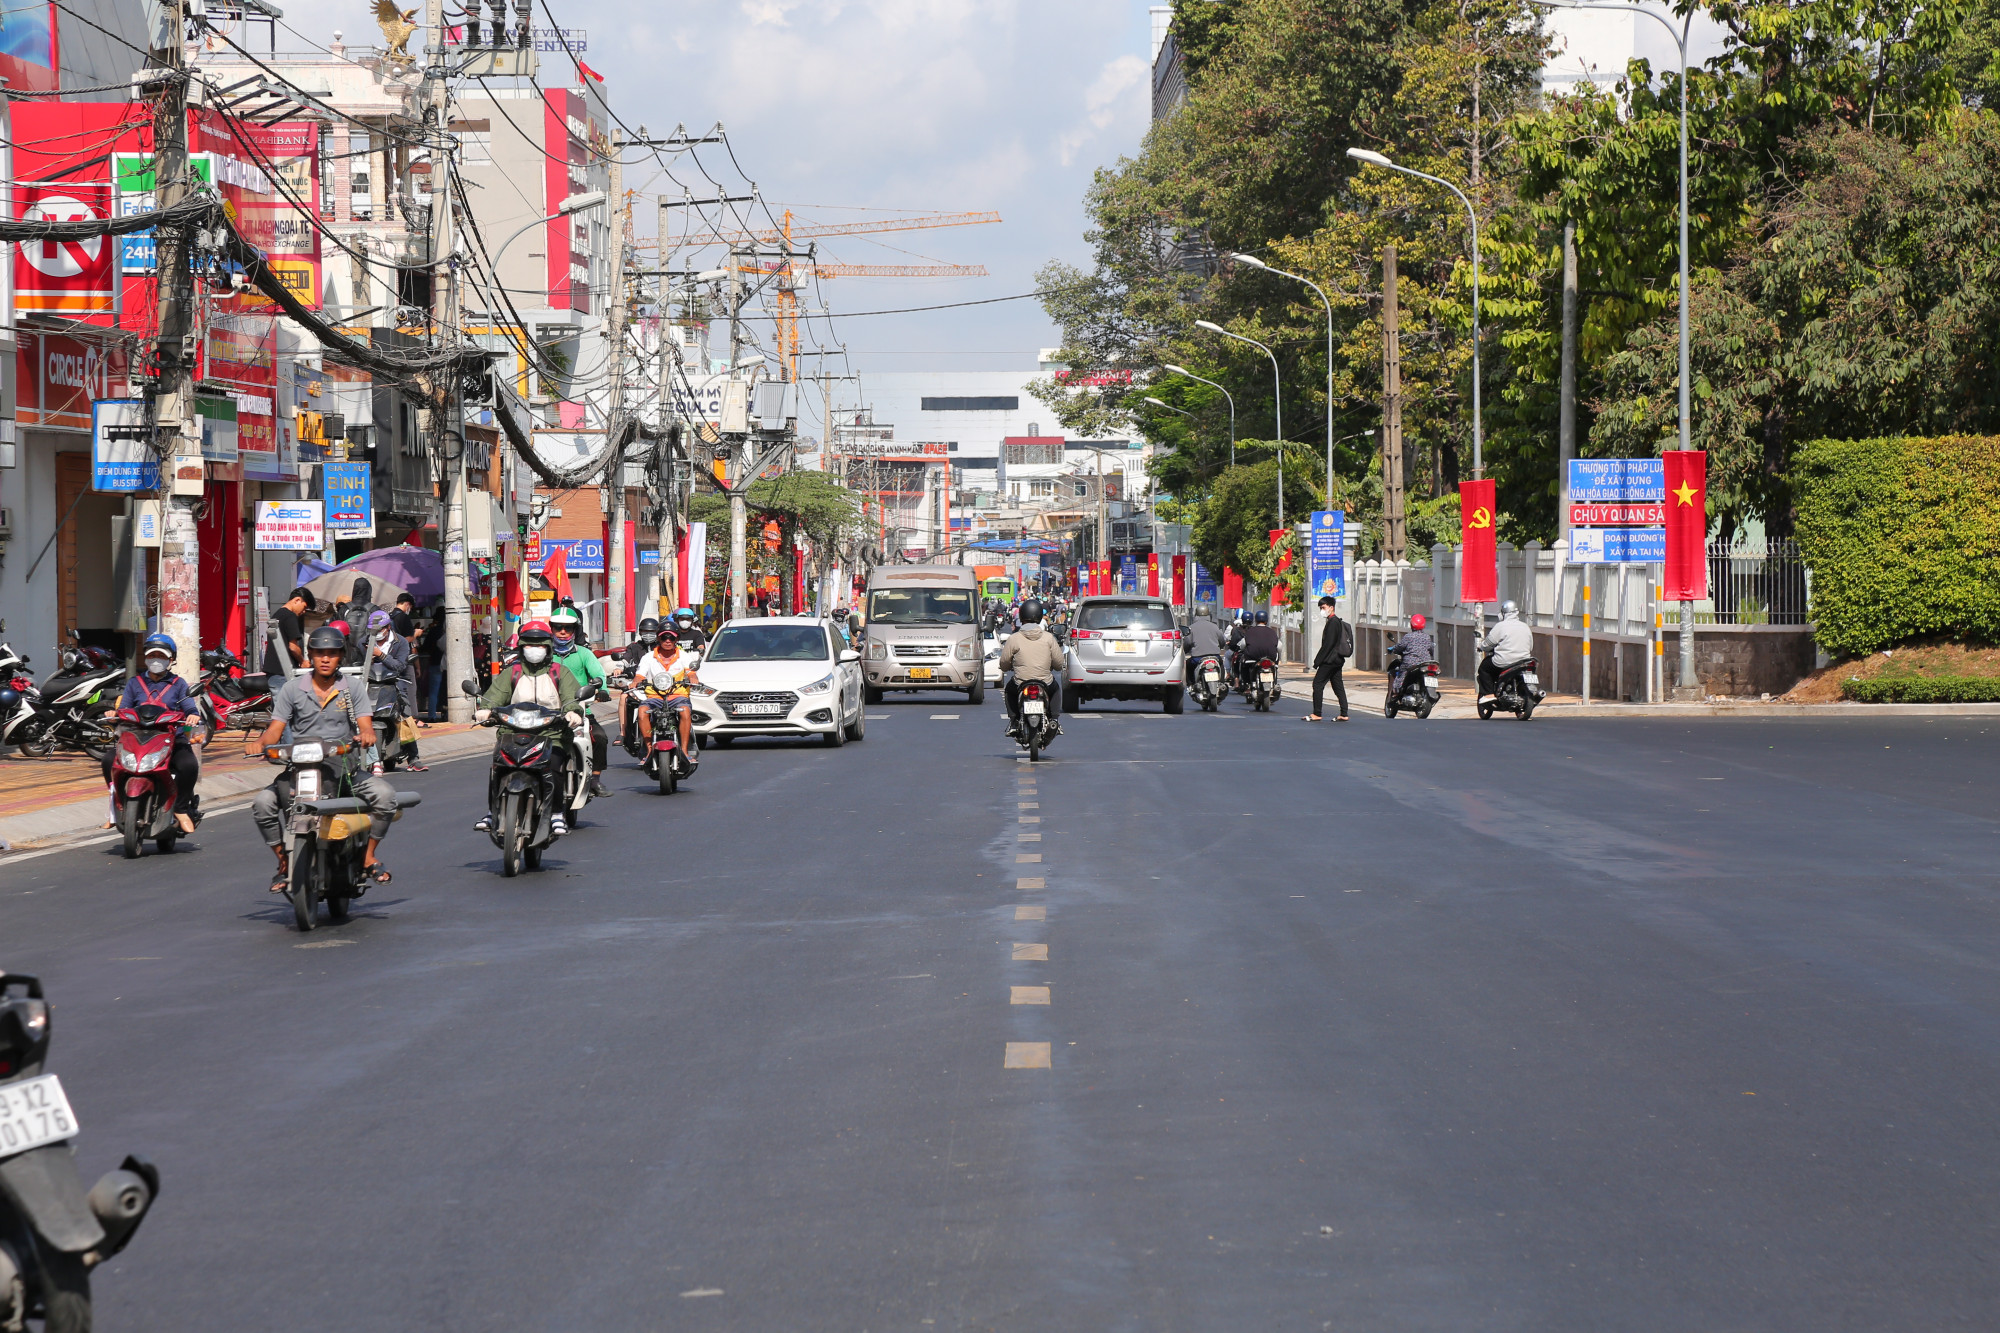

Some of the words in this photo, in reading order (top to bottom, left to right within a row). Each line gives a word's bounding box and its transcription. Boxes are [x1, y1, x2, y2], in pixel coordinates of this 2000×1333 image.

[275, 220, 297, 236] NGOẠI
[300, 220, 310, 237] TỆ
[125, 245, 156, 259] 24H
[48, 352, 83, 388] CIRCLE
[97, 464, 113, 476] ĐIỂM
[132, 467, 141, 476] XE
[328, 463, 350, 472] GIÁO
[1578, 463, 1608, 475] THƯỢNG
[1610, 461, 1626, 474] TÔN
[1627, 461, 1648, 473] PHÁP
[112, 479, 125, 487] BUS
[126, 479, 142, 487] STOP
[327, 474, 365, 490] BÌNH
[1594, 473, 1606, 485] ĐỂ
[1607, 473, 1625, 484] XÂY
[1626, 474, 1652, 485] DỰNG
[1571, 487, 1585, 498] VĂN
[1587, 487, 1600, 498] HÓA
[1602, 489, 1618, 498] GIAO
[1620, 486, 1644, 498] THÔNG
[1646, 488, 1656, 498] AN
[331, 495, 364, 511] THỌ
[265, 508, 312, 519] ABEC
[1574, 506, 1598, 522] CHÚ
[1601, 506, 1608, 521] Ý
[1610, 508, 1645, 522] QUAN
[1648, 505, 1665, 522] SẮ
[1604, 534, 1627, 544] ĐOẠN
[1629, 532, 1658, 542] ĐƯỜNG
[1627, 548, 1638, 556] RA
[1639, 548, 1651, 556] TAI
